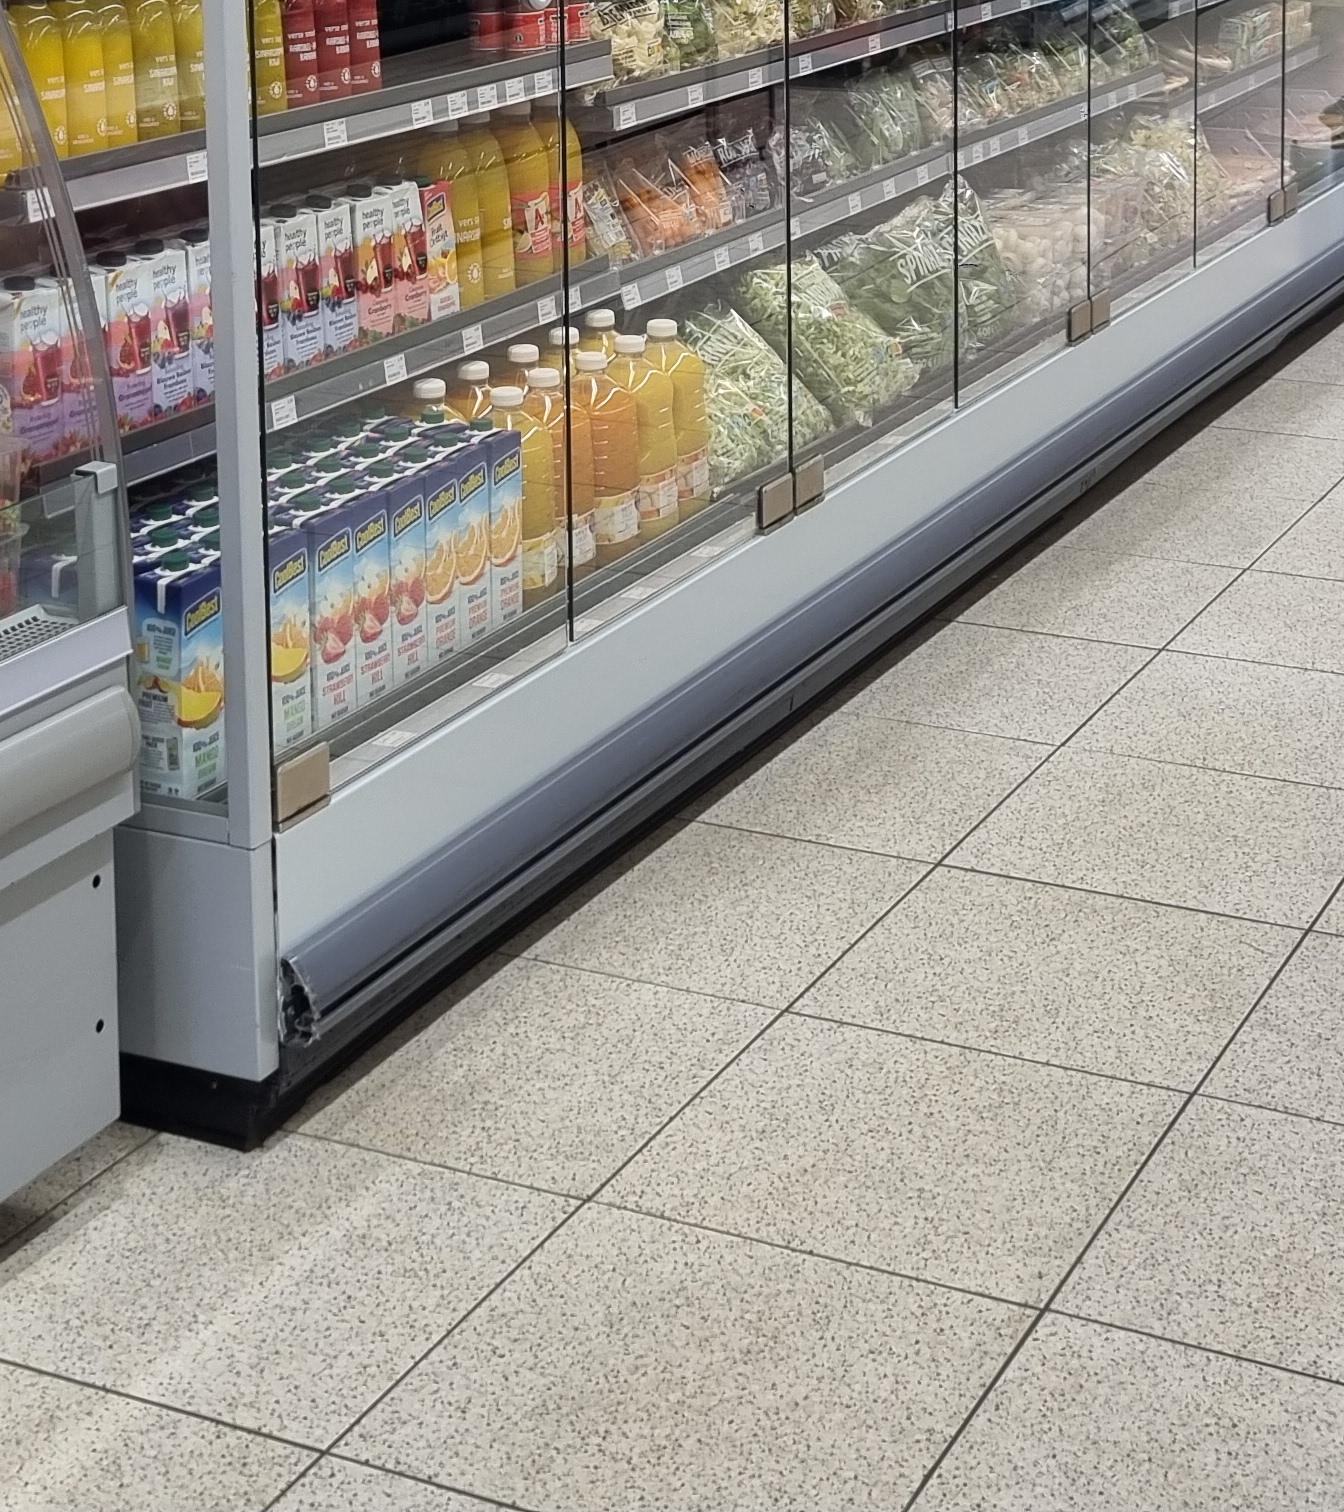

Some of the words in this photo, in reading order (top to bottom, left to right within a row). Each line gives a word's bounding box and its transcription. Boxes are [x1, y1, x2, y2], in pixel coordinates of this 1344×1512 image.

[324, 217, 344, 228] healthy
[362, 208, 385, 220] healthy
[284, 229, 307, 240] healthy
[116, 278, 138, 290] healthy
[153, 265, 176, 278] healthy
[495, 454, 520, 483] CoolBest
[460, 469, 485, 498] CoolBest
[430, 486, 455, 517] CoolBest
[394, 501, 421, 535] CoolBest
[356, 517, 385, 549] CoolBest
[319, 536, 349, 569] CoolBest
[274, 555, 306, 589] CoolBest
[186, 595, 219, 631] CoolBest
[361, 653, 391, 675] STRAWBERRY
[322, 674, 354, 696] STRAWBERRY
